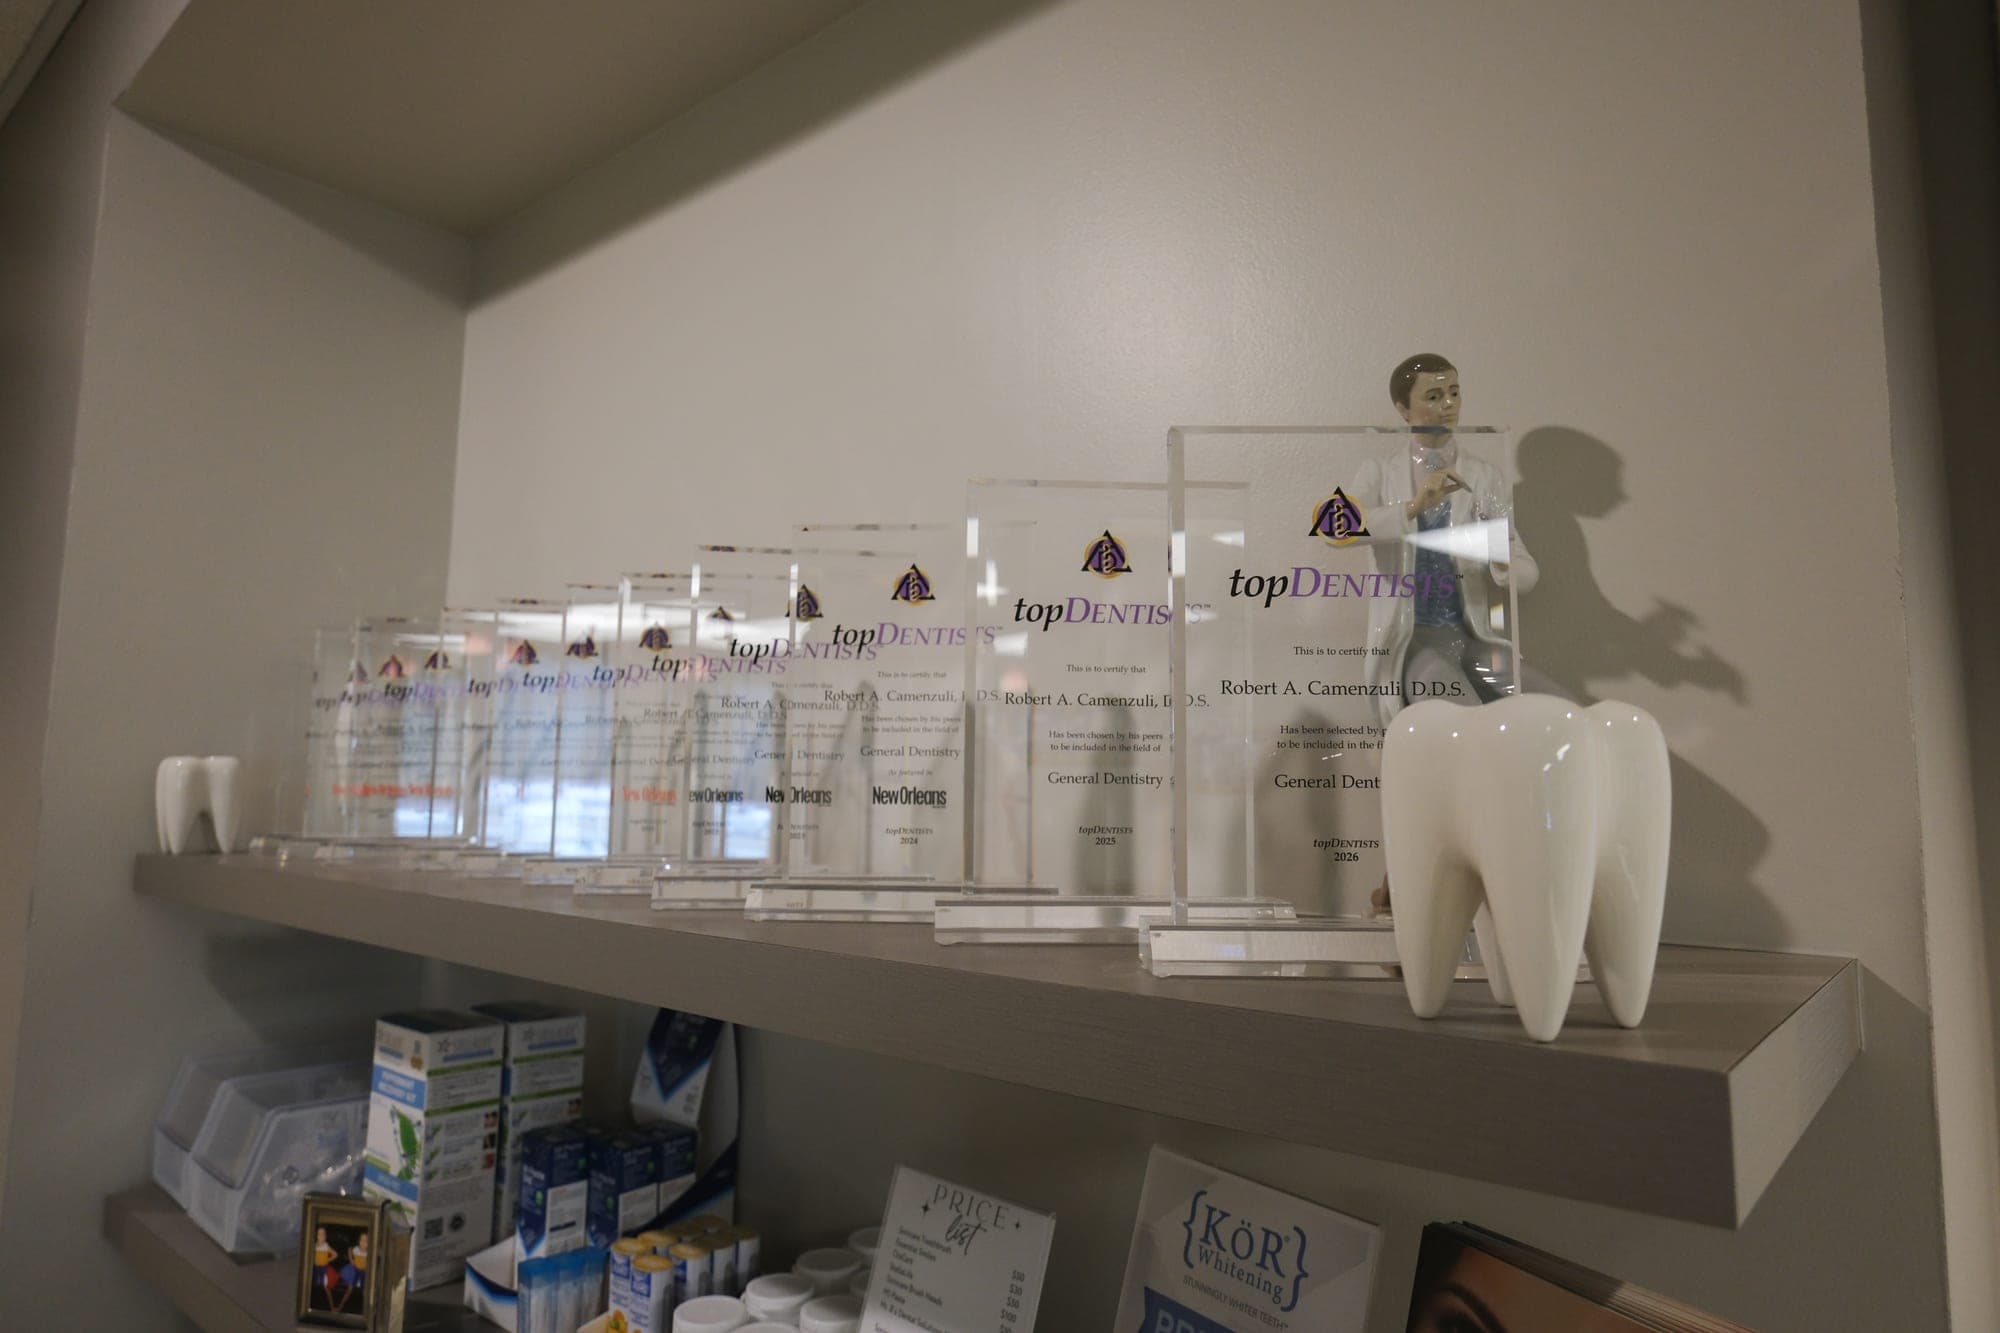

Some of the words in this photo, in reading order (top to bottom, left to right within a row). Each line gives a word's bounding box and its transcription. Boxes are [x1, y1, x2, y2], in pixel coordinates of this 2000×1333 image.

[1293, 646, 1314, 656] This
[1316, 646, 1325, 656] is
[1327, 646, 1336, 656] to
[1339, 646, 1368, 659] certify
[1371, 646, 1390, 656] that
[1066, 664, 1083, 673] This
[1085, 664, 1092, 673] is
[1094, 664, 1102, 673] to
[1103, 665, 1129, 676] certify
[1130, 665, 1146, 674] that
[1220, 679, 1277, 697] Robert
[1283, 680, 1302, 697] A.
[1411, 681, 1466, 697] D.D.S.
[824, 689, 865, 702] Robert
[869, 690, 884, 702] A.
[886, 690, 958, 704] Camenzuli,
[1005, 692, 1051, 706] Robert
[1057, 693, 1072, 706] A.
[1077, 694, 1159, 709] Camenzuli,
[1048, 730, 1064, 740] Has
[1066, 730, 1086, 740] been
[1087, 731, 1115, 740] chosen
[1116, 731, 1126, 742] by
[1128, 731, 1140, 741] his
[1142, 733, 1163, 742] peers
[1280, 725, 1299, 735] Has
[1301, 725, 1323, 735] been
[1326, 725, 1364, 736] selected
[1366, 725, 1379, 737] by
[1051, 743, 1059, 752] to
[1060, 743, 1070, 752] be
[1072, 743, 1106, 752] included
[1109, 743, 1117, 752] in
[1119, 743, 1132, 752] the
[1133, 744, 1151, 753] field
[1153, 744, 1161, 753] of
[1277, 741, 1287, 750] to
[1289, 740, 1300, 750] be
[1303, 740, 1345, 750] included
[1347, 740, 1357, 750] in
[1359, 740, 1375, 750] the
[860, 745, 905, 758] General
[908, 746, 960, 760] Dentistry
[1047, 771, 1099, 785] General
[1104, 772, 1164, 789] Dentistry
[1274, 774, 1336, 789] General
[899, 837, 918, 845] 2024
[1095, 837, 1116, 846] 2025
[1313, 837, 1379, 850] topDENTISTS
[1333, 852, 1359, 862] 2026
[932, 1183, 1010, 1230] PRICE
[944, 1213, 988, 1256] list
[1197, 1244, 1285, 1306] Whitening
